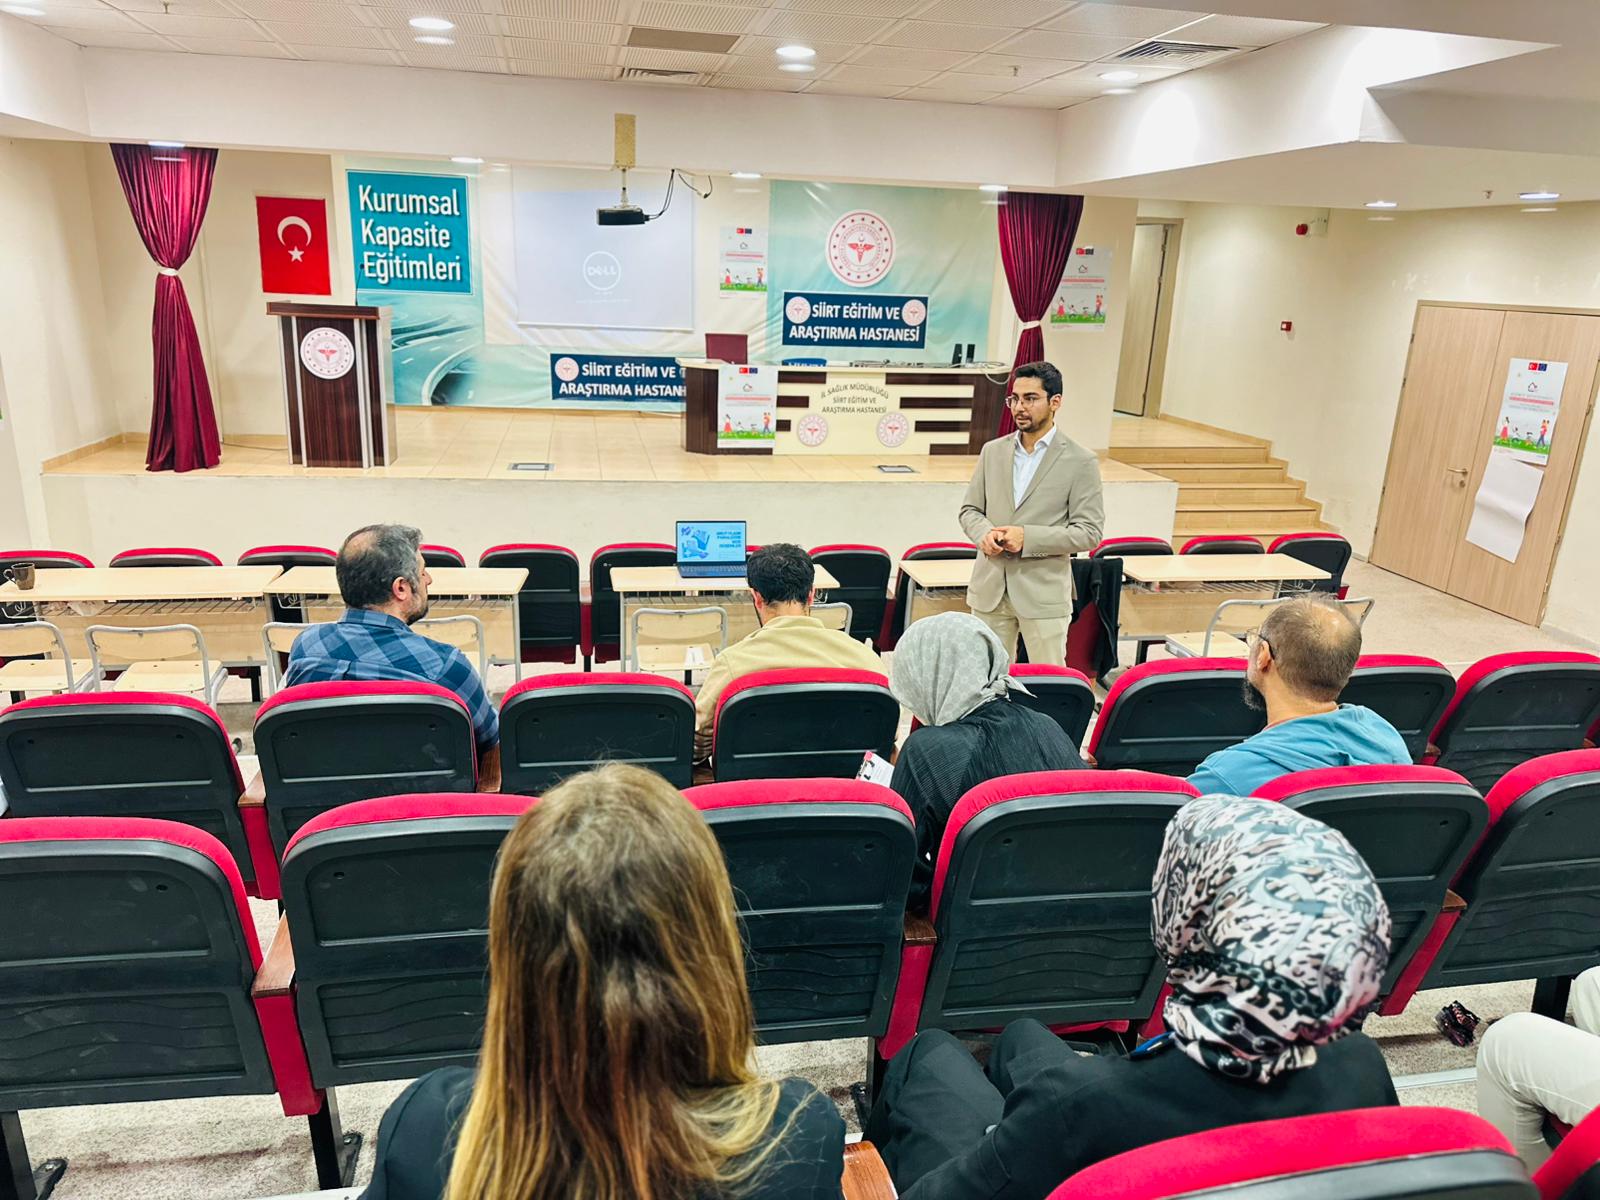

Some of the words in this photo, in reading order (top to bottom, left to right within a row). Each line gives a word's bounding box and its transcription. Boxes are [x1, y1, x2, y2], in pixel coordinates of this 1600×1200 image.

[359, 184, 460, 216] Kurumsal
[361, 218, 451, 252] Kapasite
[363, 251, 461, 284] Eğitimleri
[587, 265, 616, 276] DELL
[812, 302, 841, 318] SİİRT
[843, 303, 883, 319] EĞİTİM
[885, 306, 900, 320] VE
[789, 326, 857, 342] ARAŞTIRMA
[860, 326, 920, 342] HASTANESİ
[582, 362, 613, 377] SİİRT
[615, 363, 658, 378] EĞİTİM
[660, 366, 676, 378] VE
[559, 383, 632, 397] ARAŞTIRMA
[827, 383, 849, 396] SAĞLIK
[847, 396, 868, 404] EĞİTİM
[821, 406, 855, 414] ARAŞTIRMA
